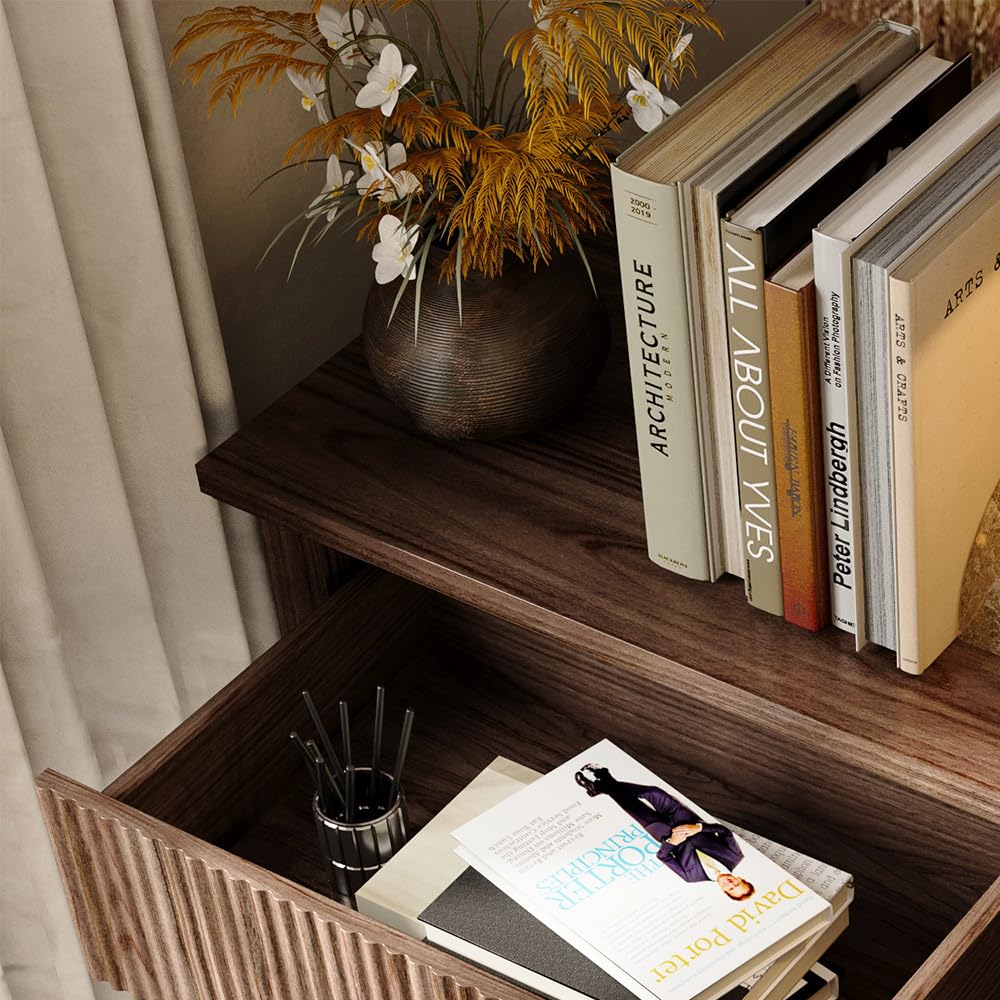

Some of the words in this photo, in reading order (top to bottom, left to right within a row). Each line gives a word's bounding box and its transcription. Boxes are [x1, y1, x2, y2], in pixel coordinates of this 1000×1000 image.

[630, 197, 650, 210] 2000
[631, 206, 652, 218] 2019
[726, 242, 759, 314] ALL
[943, 269, 984, 320] ARTS
[831, 291, 842, 344] Photography
[894, 312, 906, 349] ARTS
[632, 259, 670, 458] ARCHITECTURE
[661, 332, 674, 402] MODERN
[824, 340, 832, 376] Different
[824, 376, 832, 384] A
[832, 346, 842, 376] Fashion
[834, 376, 842, 388] on
[896, 355, 906, 366] &
[732, 326, 769, 466] ABOUT
[896, 373, 908, 423] CRAFTS
[826, 421, 850, 532] Lindbergh
[742, 480, 775, 563] YVES
[832, 534, 852, 590] Peter
[536, 824, 646, 893] PRINCIPLES
[544, 834, 662, 911] PORTER
[623, 858, 661, 884] THE
[726, 879, 806, 934] David
[649, 927, 733, 984] Porter
